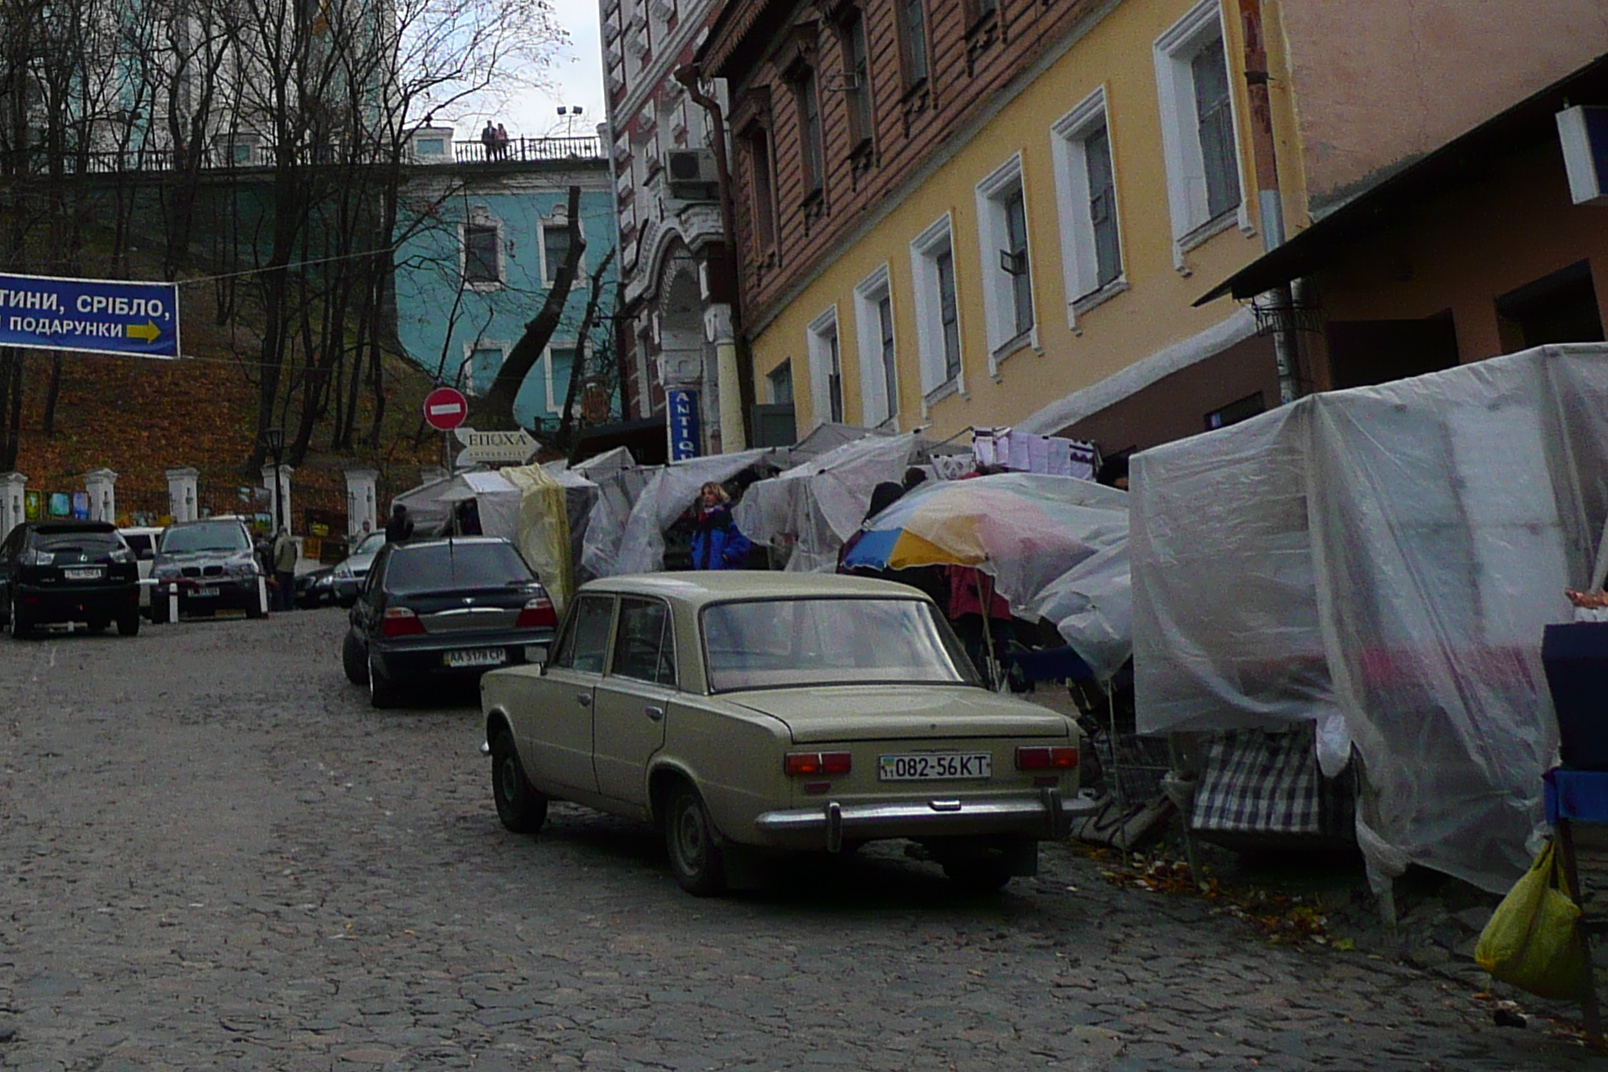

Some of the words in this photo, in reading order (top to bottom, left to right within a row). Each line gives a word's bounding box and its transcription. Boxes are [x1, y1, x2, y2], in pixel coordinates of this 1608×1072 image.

[75, 293, 171, 322] СРІБЛО,
[8, 316, 123, 339] ПОДАРУНКИ
[468, 434, 528, 447] ЕПОХА
